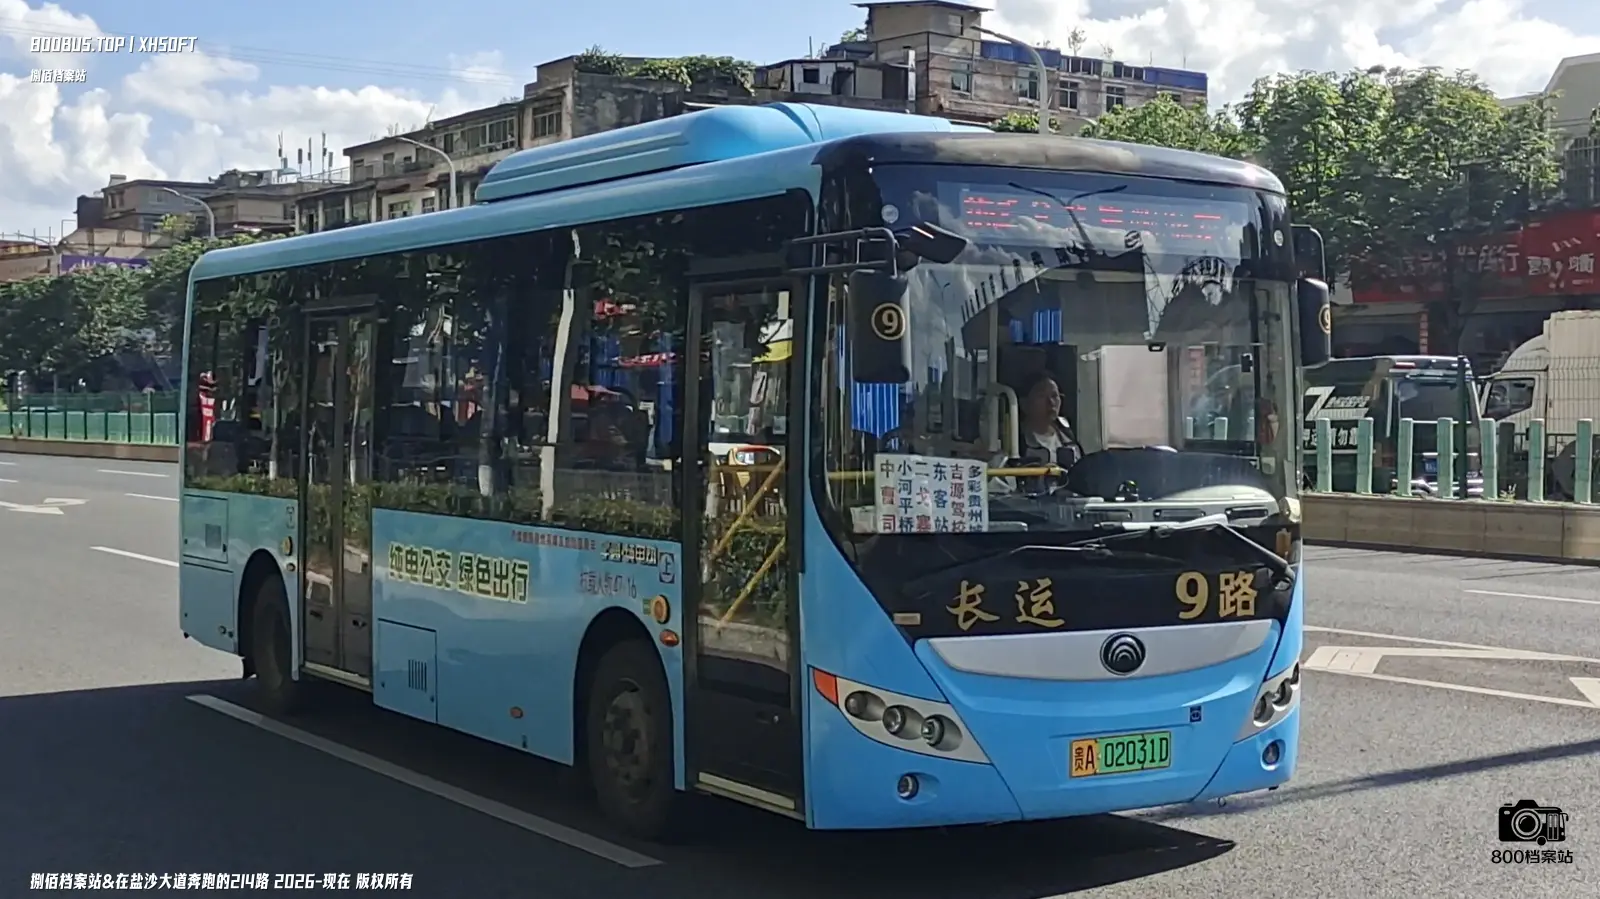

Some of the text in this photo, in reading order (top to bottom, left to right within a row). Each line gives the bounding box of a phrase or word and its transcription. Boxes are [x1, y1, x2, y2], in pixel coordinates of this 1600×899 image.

[882, 309, 899, 334] 9
[388, 542, 529, 604] 纯电公交 绿色出行
[946, 577, 1065, 631] 长运
